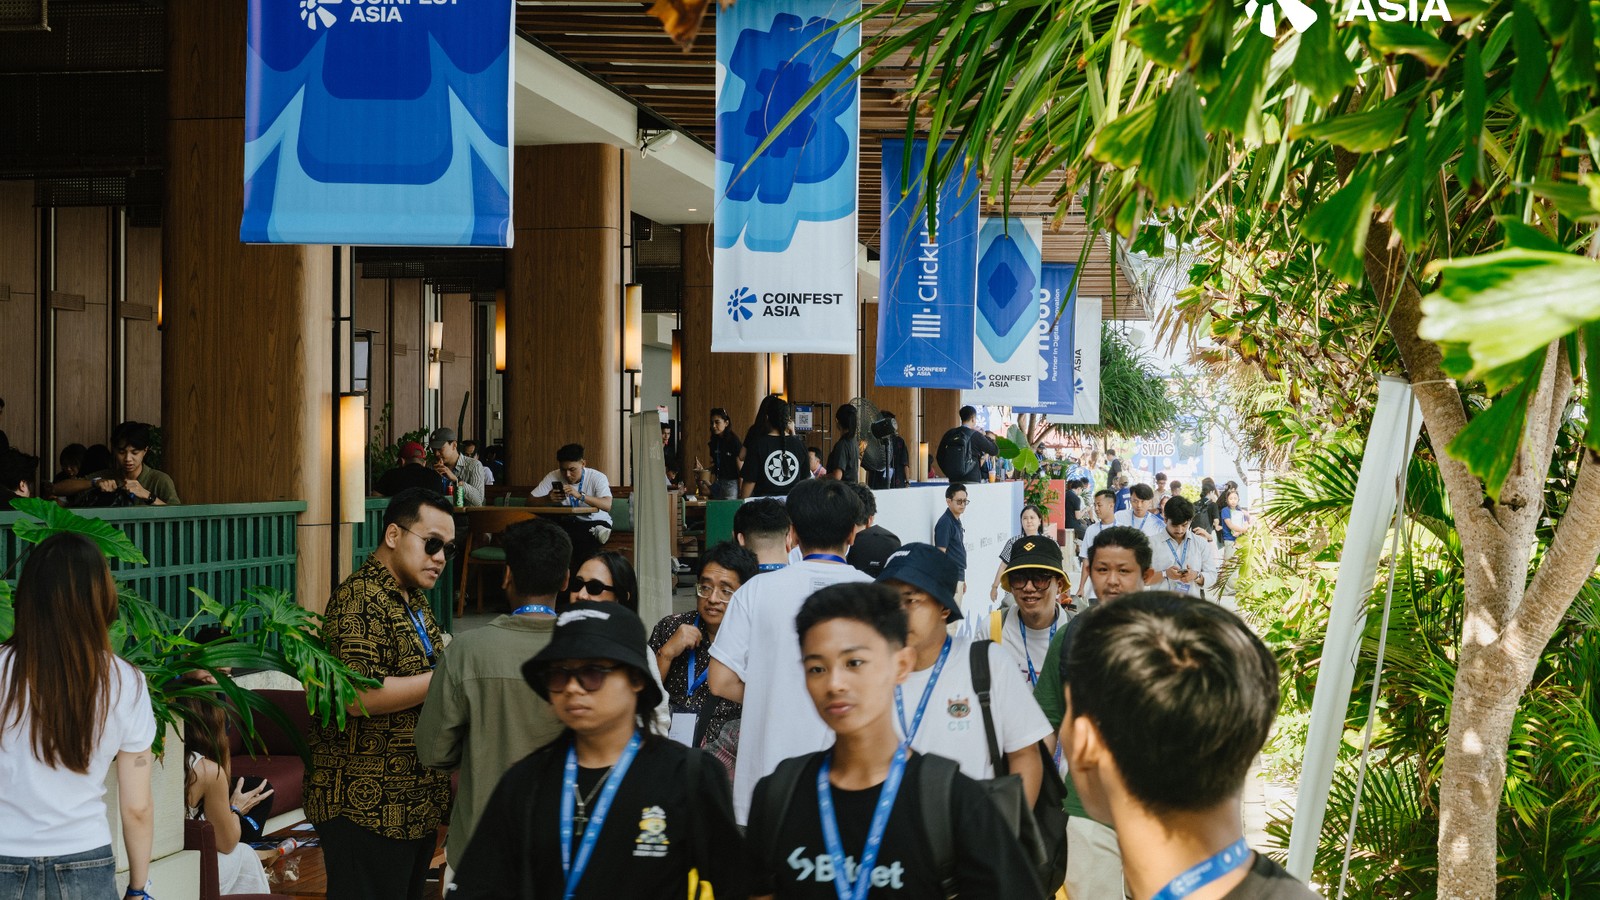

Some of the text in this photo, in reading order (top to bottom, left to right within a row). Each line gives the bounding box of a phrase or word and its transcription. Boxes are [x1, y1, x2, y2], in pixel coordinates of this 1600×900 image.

[350, 6, 403, 23] ASIA
[762, 292, 843, 305] COINFEST
[762, 305, 800, 317] ASIA
[1074, 349, 1082, 372] ASIA
[988, 374, 1032, 382] COINFEST
[1142, 443, 1174, 456] SWAG
[947, 720, 970, 731] CST
[815, 853, 904, 889] Btet
